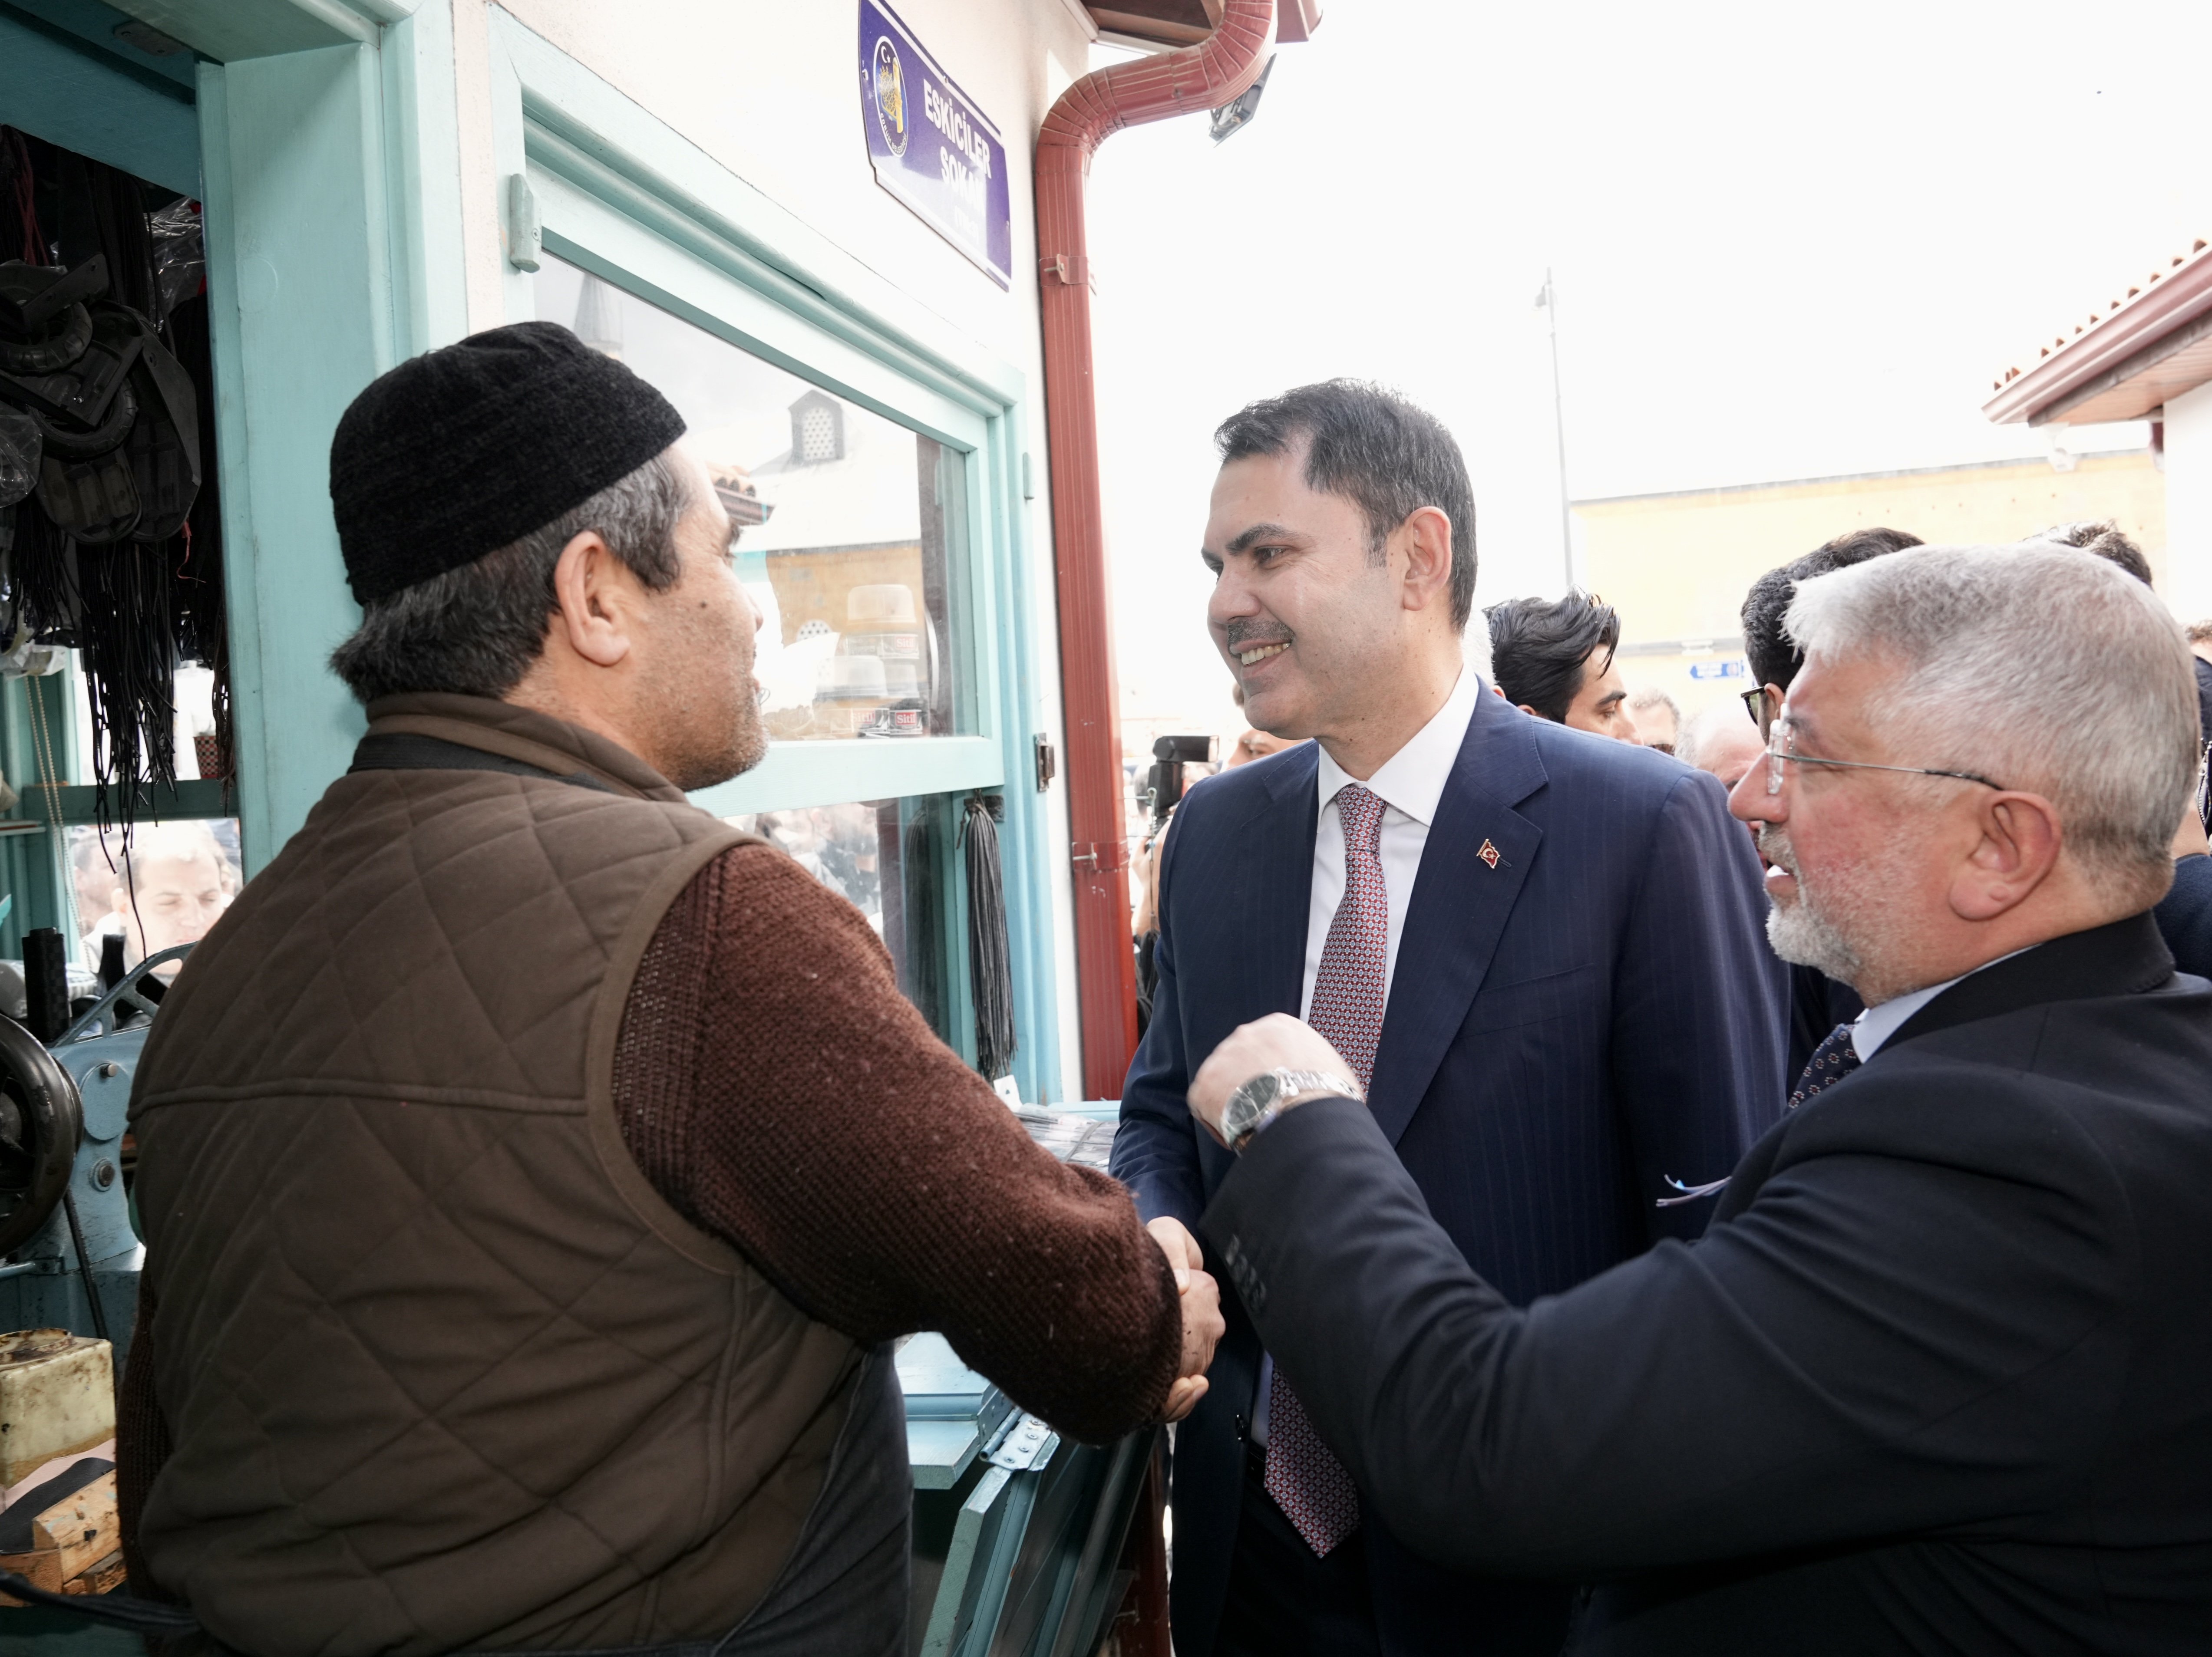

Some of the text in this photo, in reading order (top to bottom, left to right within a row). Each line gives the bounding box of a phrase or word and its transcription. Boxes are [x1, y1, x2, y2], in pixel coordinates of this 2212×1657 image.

[923, 79, 992, 179] ESKİCİLER
[897, 638, 914, 648] Sitil
[897, 714, 916, 724] Sitil
